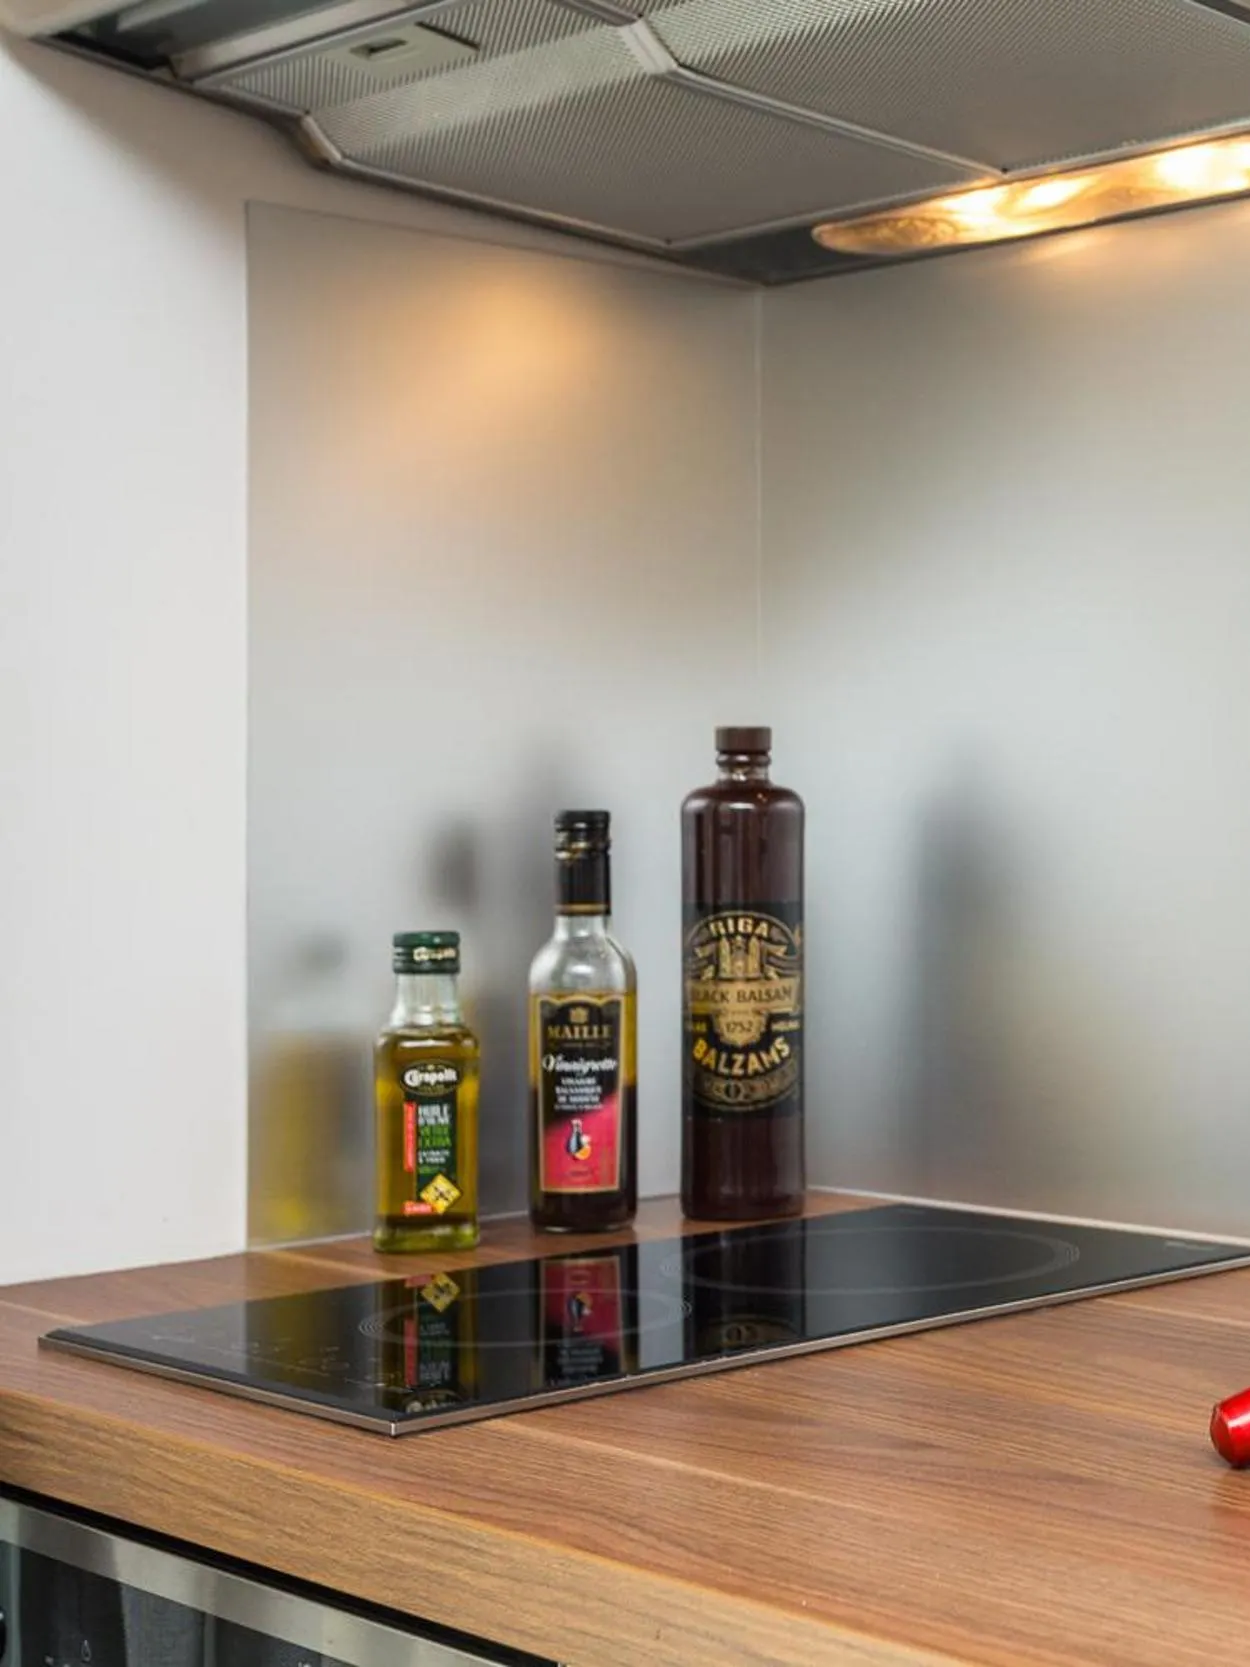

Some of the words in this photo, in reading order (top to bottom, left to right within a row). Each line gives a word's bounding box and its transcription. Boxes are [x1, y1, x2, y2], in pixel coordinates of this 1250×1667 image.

[709, 917, 769, 938] RIGA
[546, 1025, 613, 1040] MAILLE
[693, 1036, 791, 1077] BALZAMS
